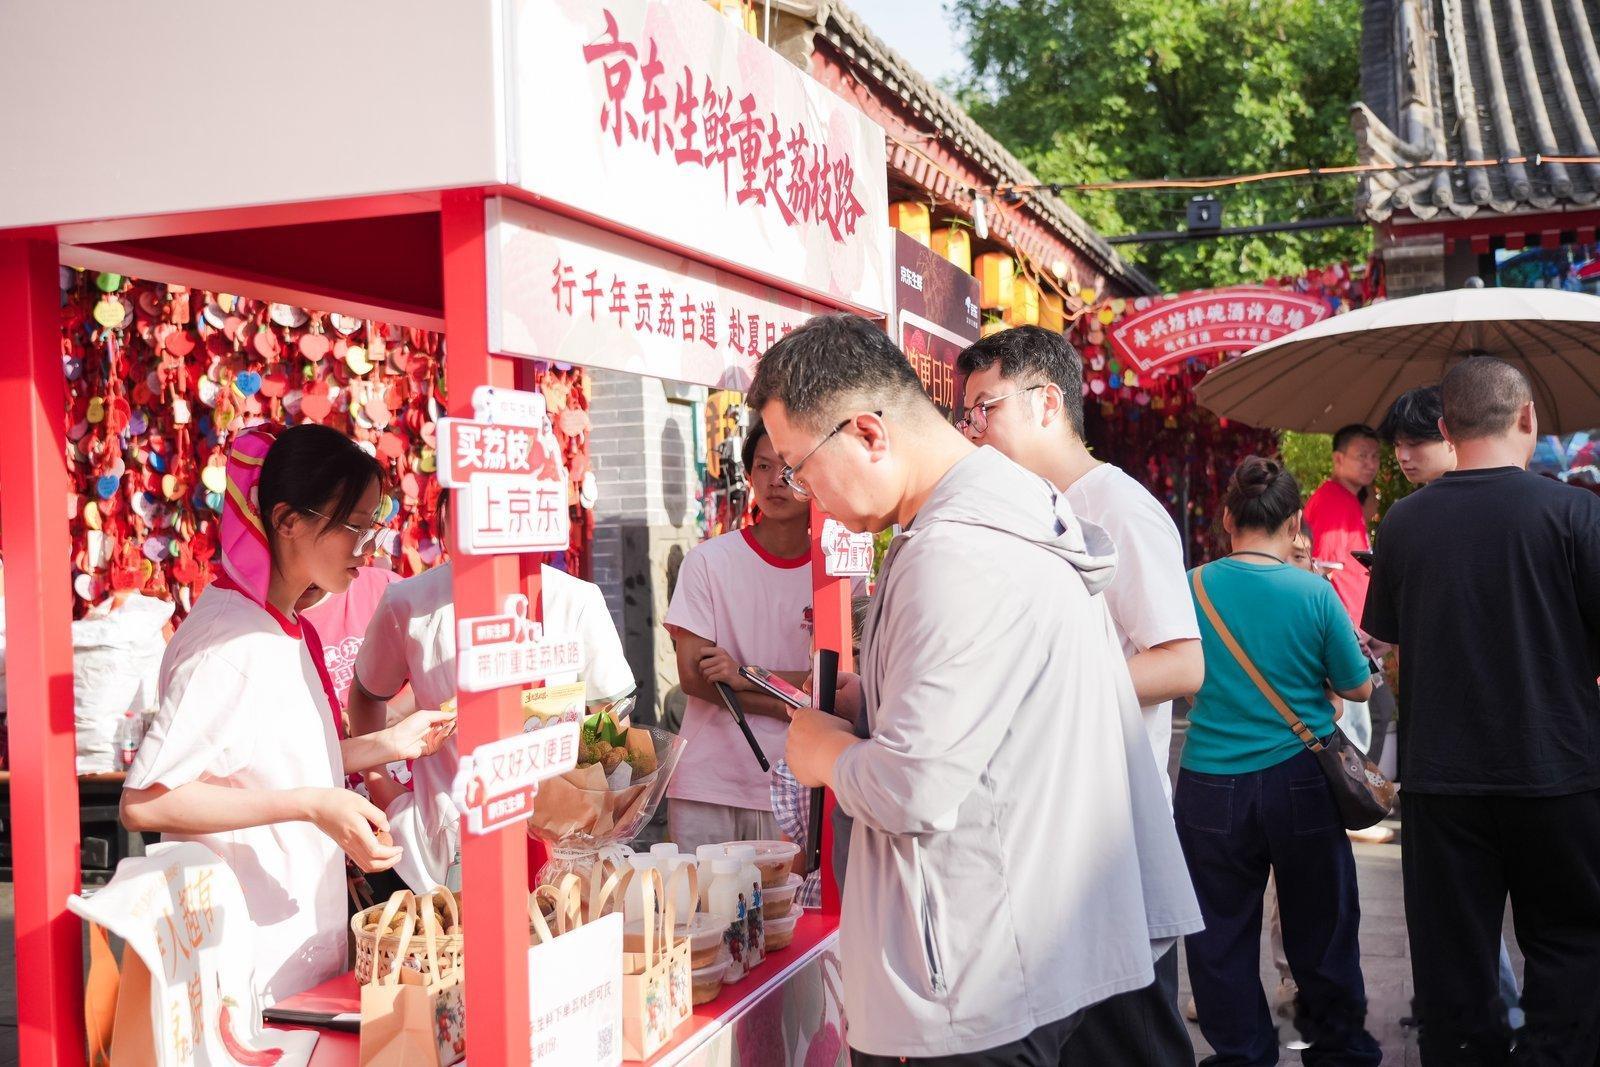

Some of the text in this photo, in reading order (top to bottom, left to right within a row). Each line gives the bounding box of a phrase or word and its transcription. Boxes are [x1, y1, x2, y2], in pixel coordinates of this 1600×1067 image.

[582, 8, 865, 245] 京东生鲜重走荔枝路
[552, 257, 717, 350] 行千年贡荔古道
[457, 425, 530, 470] 买荔枝
[478, 486, 560, 533] 上京东
[478, 641, 579, 679] 带你重走荔枝路
[490, 733, 573, 787] 又好又便宜
